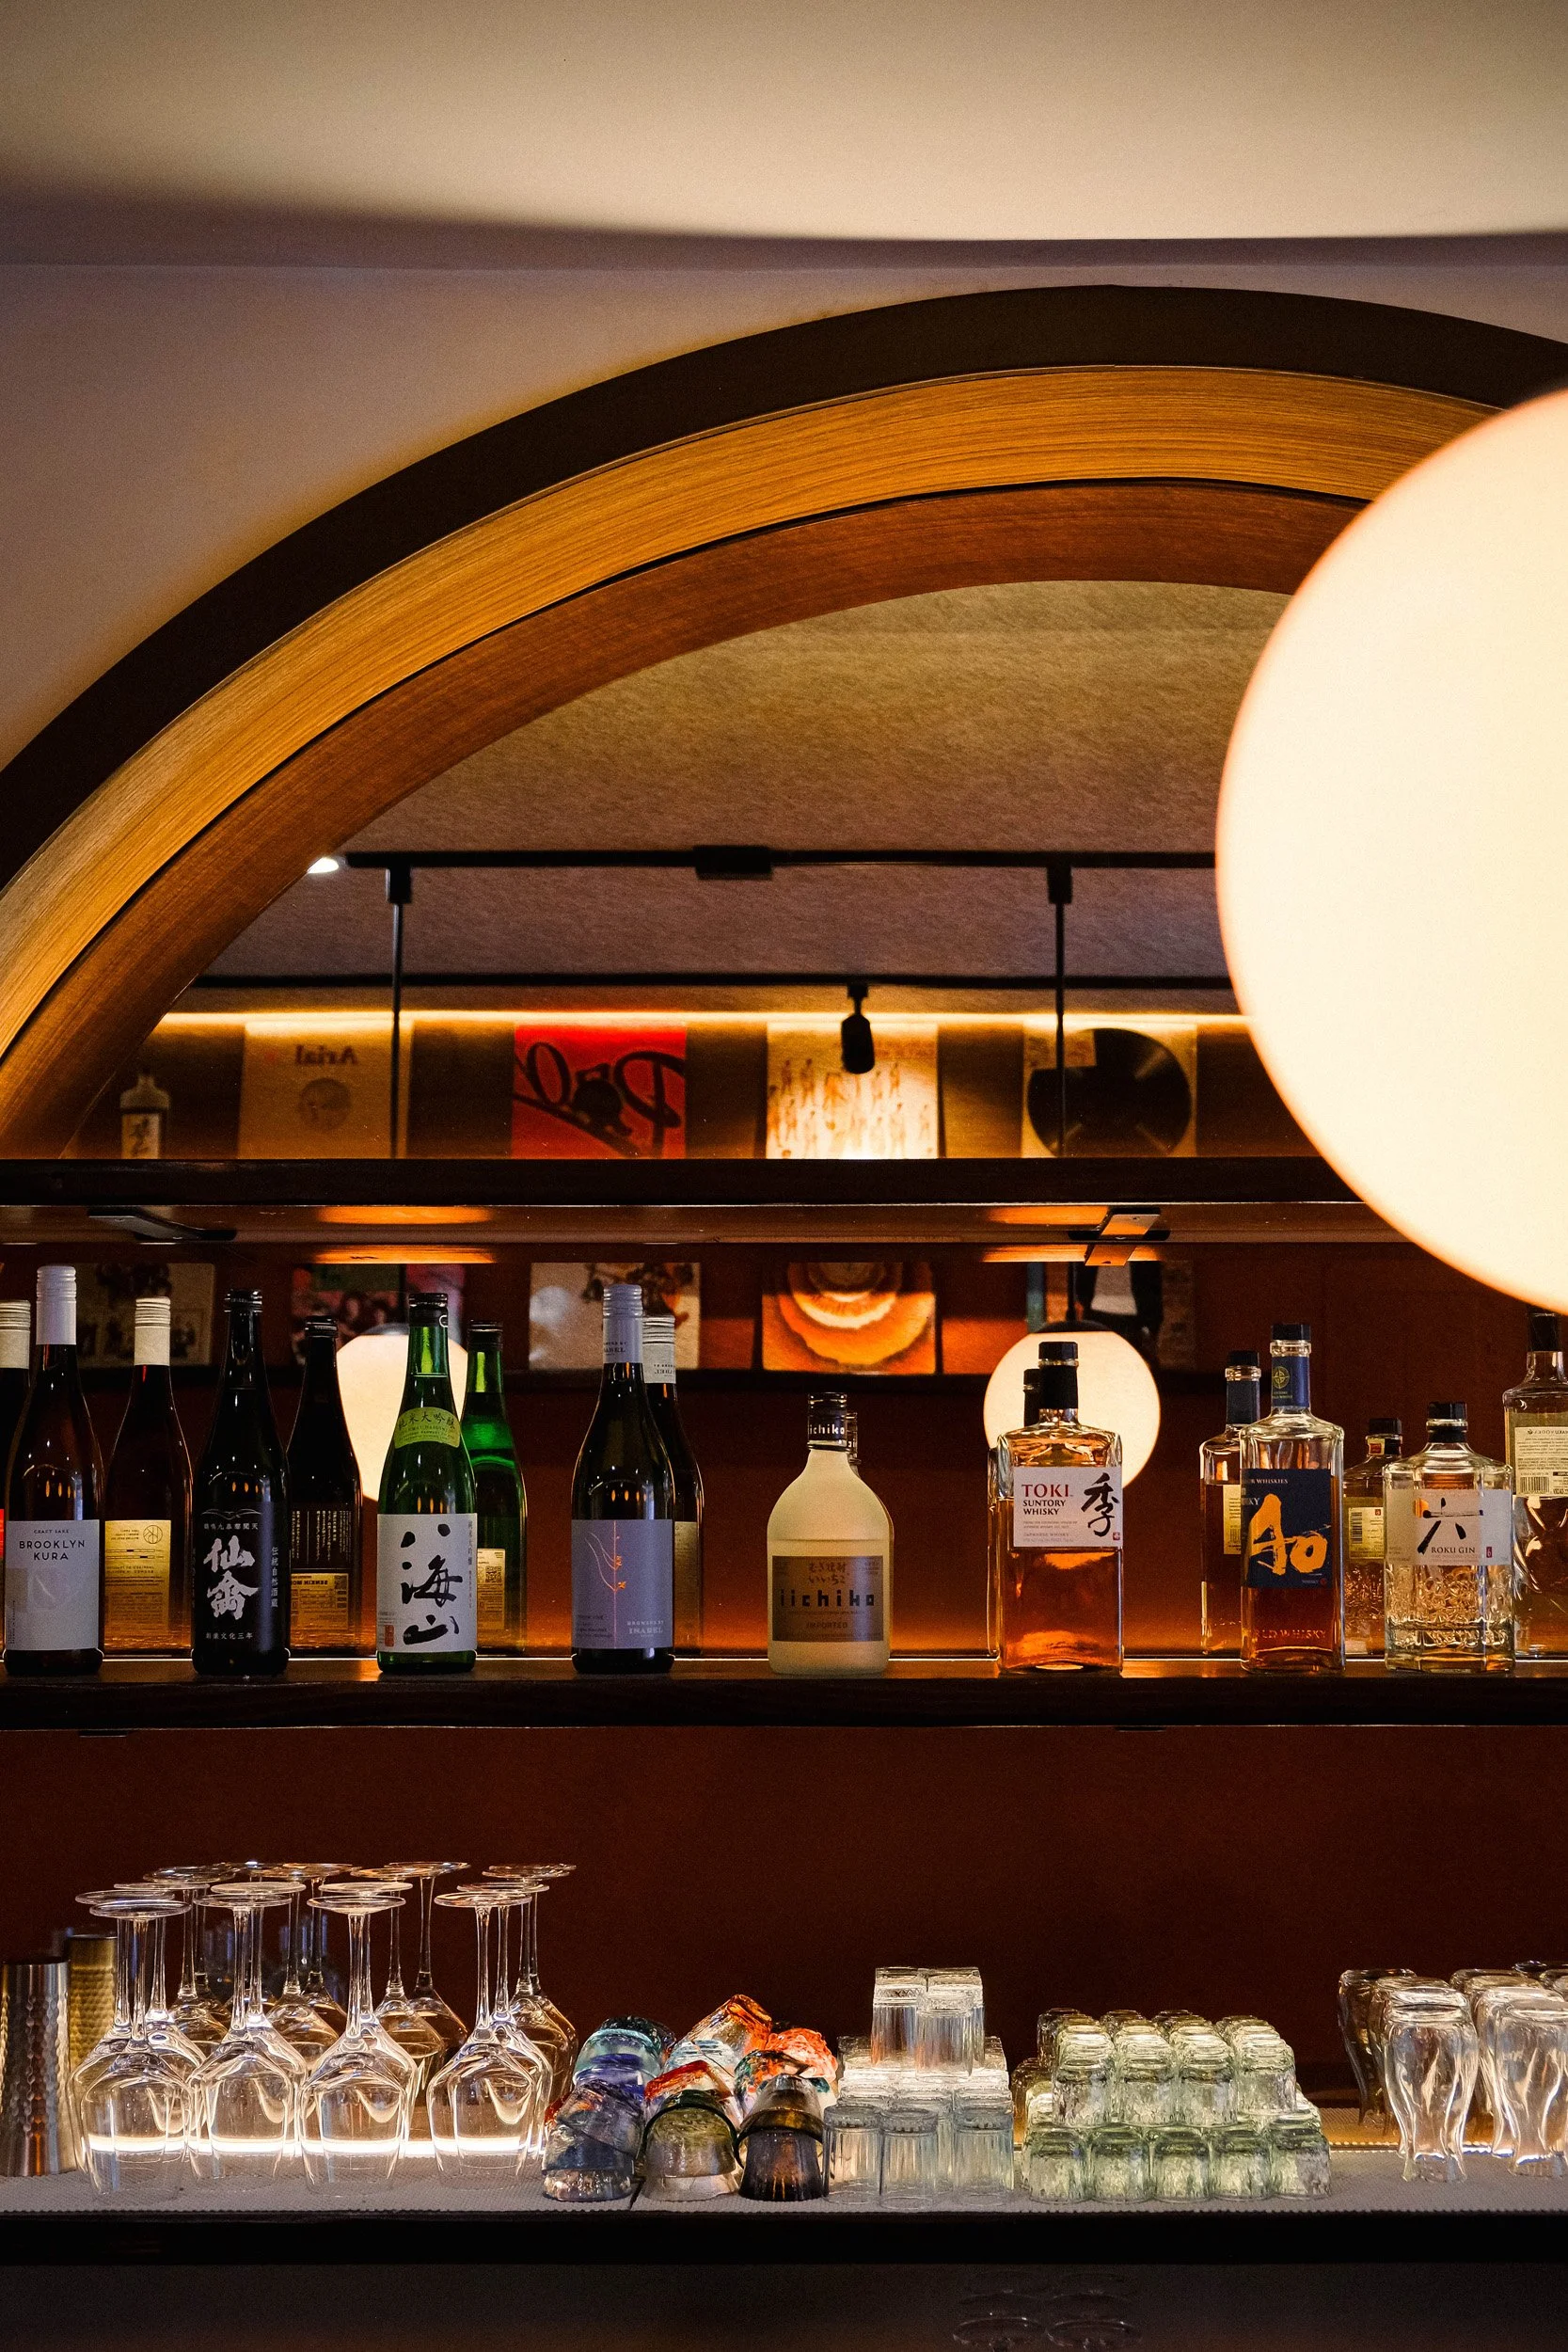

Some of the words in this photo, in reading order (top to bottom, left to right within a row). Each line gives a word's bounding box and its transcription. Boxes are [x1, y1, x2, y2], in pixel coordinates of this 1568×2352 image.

[810, 1423, 845, 1434] ichiko
[1022, 1483, 1069, 1498] TOKI
[1022, 1499, 1067, 1507] SUNTORY
[1081, 1472, 1120, 1537] 季
[1022, 1507, 1060, 1516] WHISKY
[1417, 1497, 1484, 1555] 六
[19, 1540, 85, 1549] BROOKLYN
[33, 1552, 69, 1561] KURA
[401, 1523, 464, 1645] 八海山
[780, 1589, 875, 1608] iichiko
